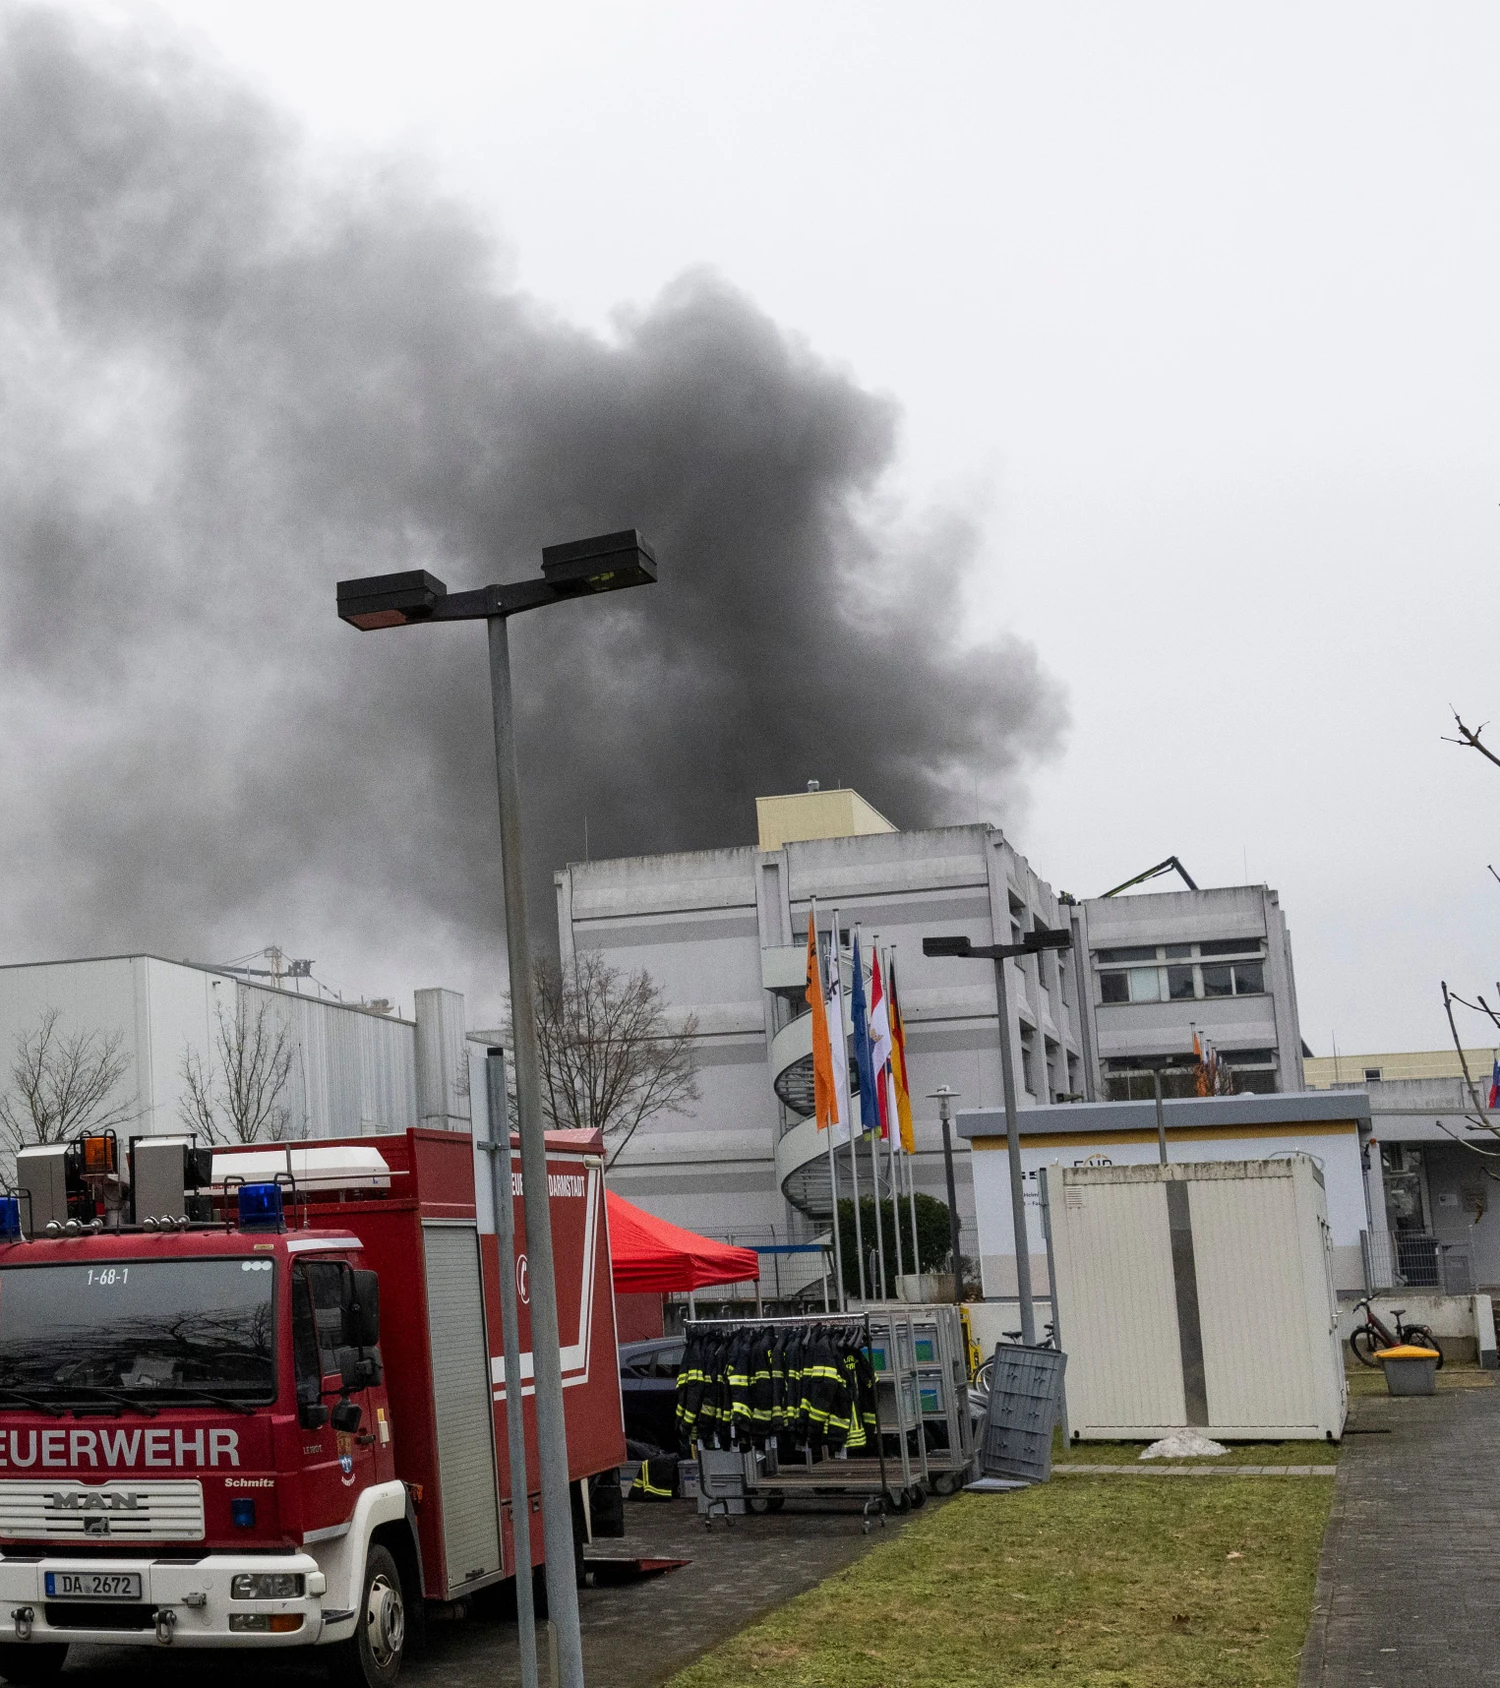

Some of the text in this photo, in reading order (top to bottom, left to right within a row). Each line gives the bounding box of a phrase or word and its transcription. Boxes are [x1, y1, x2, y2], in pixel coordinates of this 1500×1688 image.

[548, 1175, 585, 1197] DARMSTADT
[88, 1268, 129, 1285] 1-68-1
[225, 1478, 275, 1488] Schmitz
[53, 1492, 138, 1509] MAN
[62, 1576, 131, 1594] DA 2672
